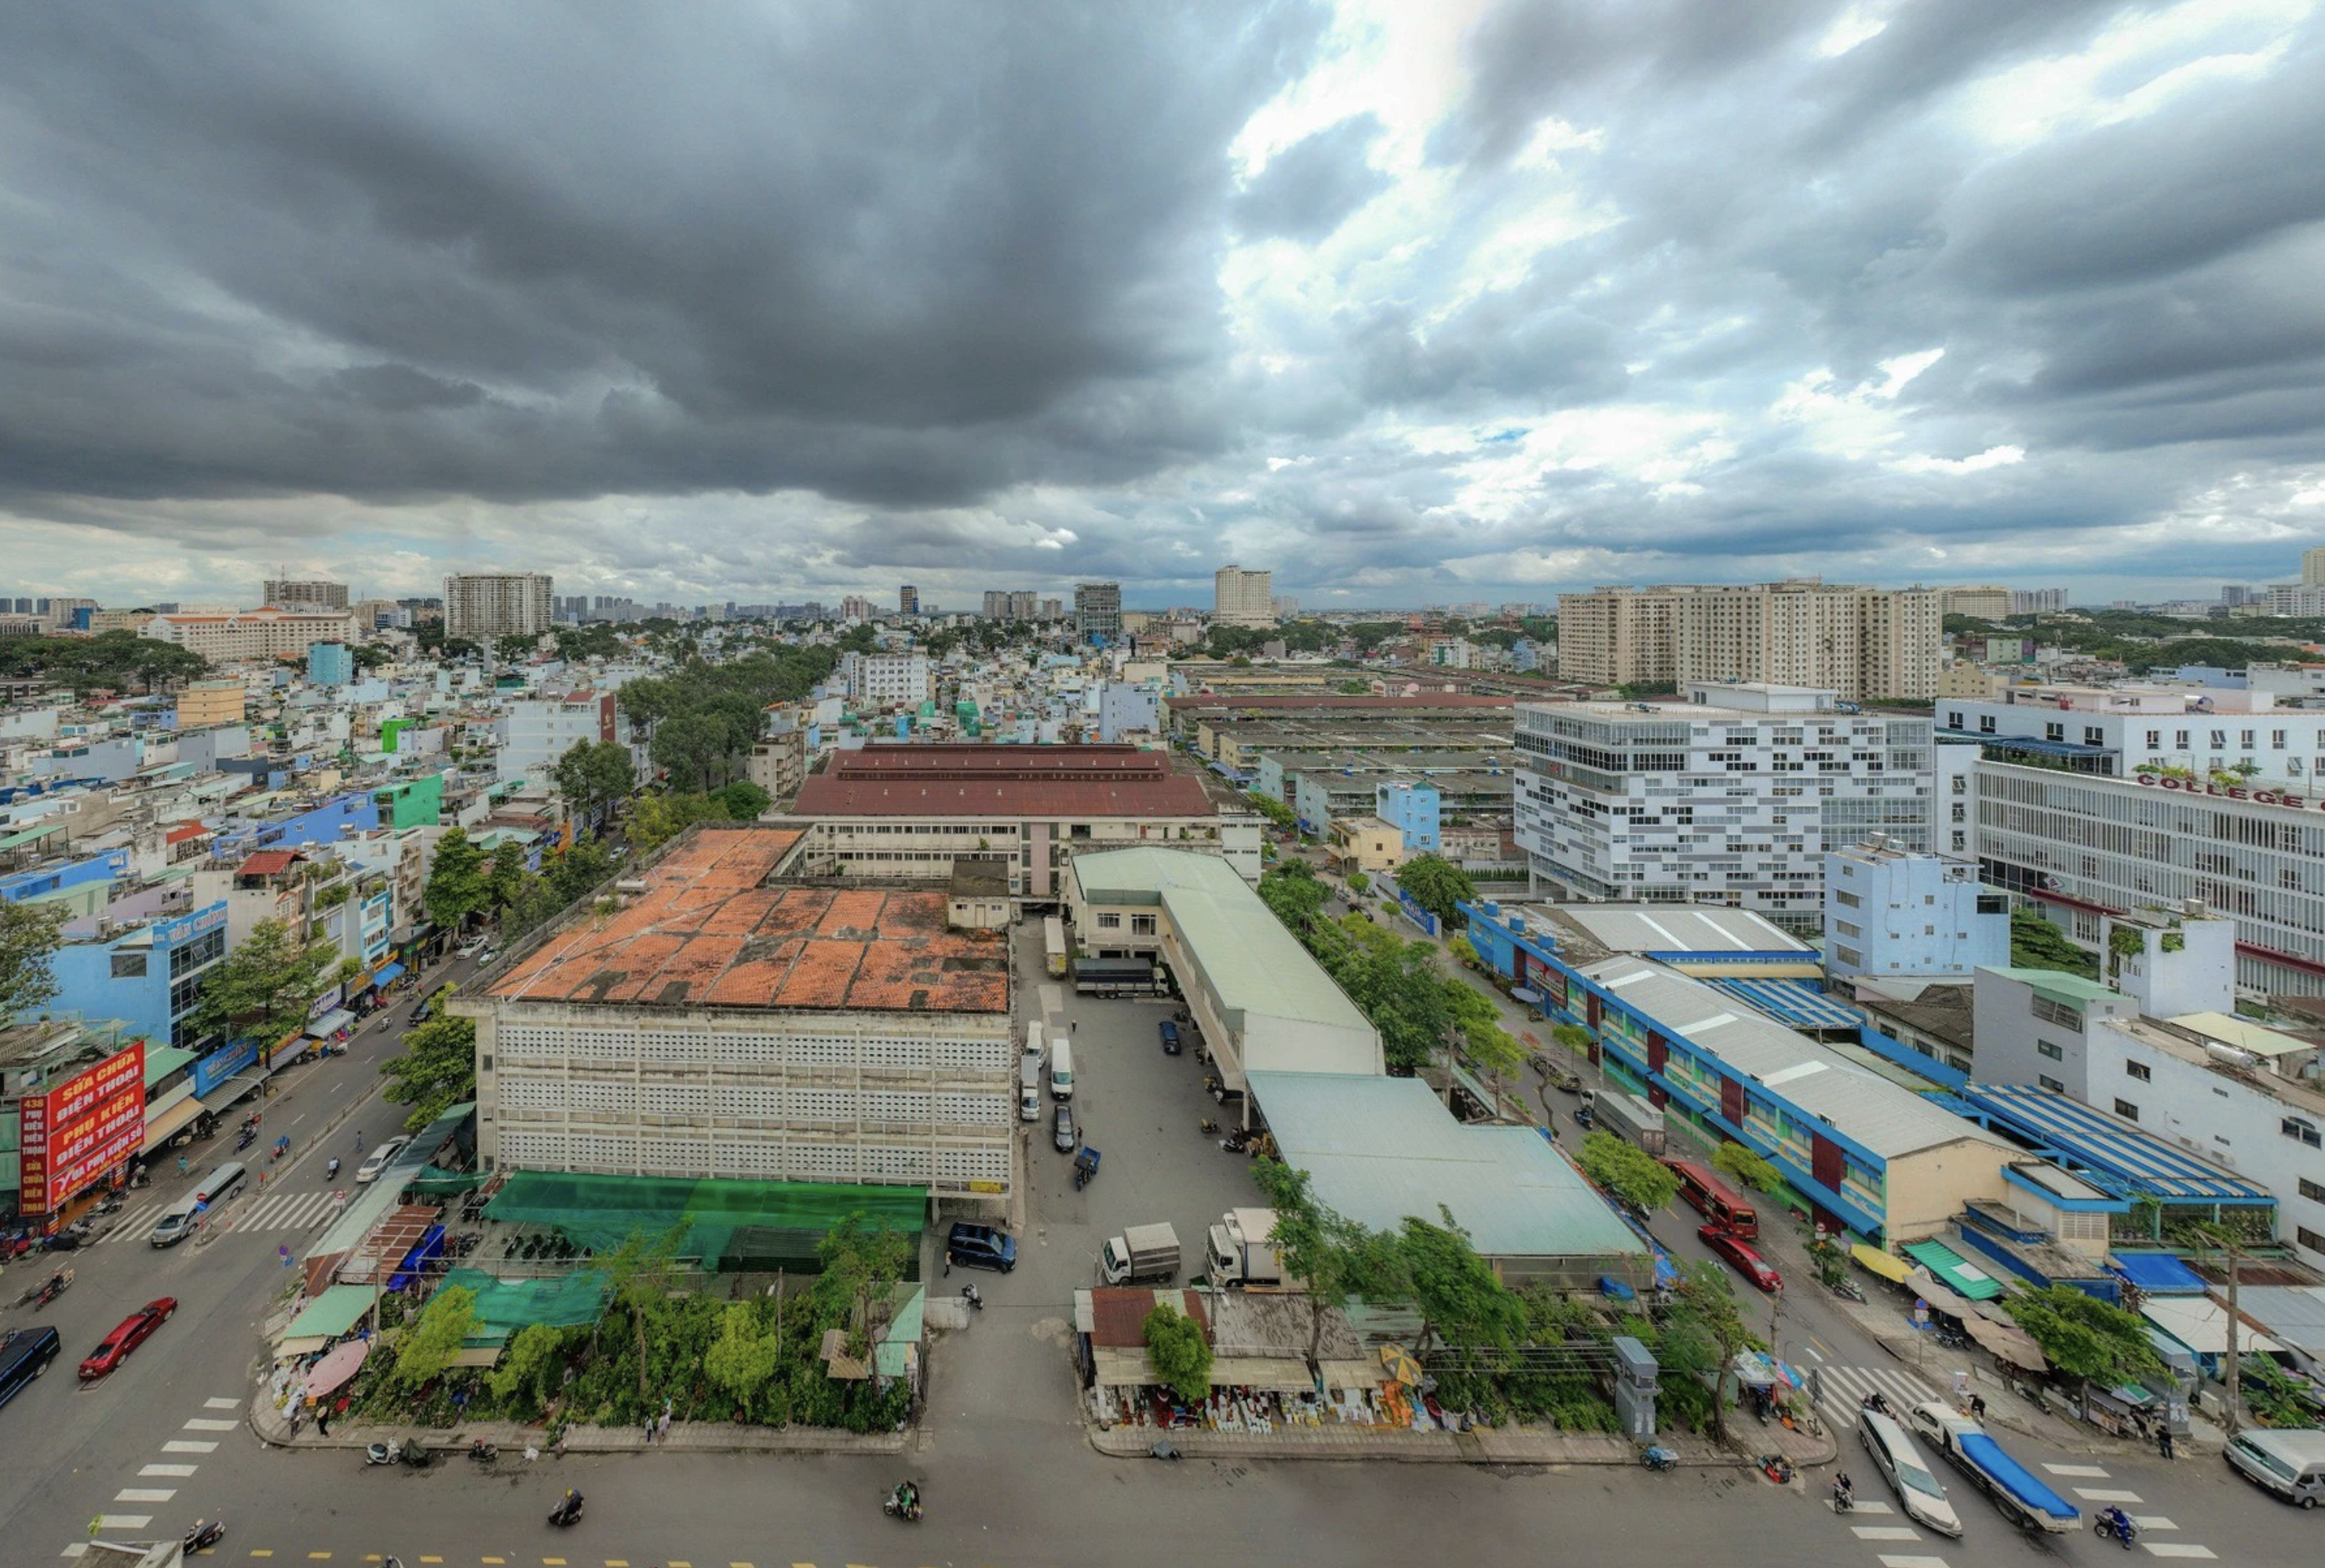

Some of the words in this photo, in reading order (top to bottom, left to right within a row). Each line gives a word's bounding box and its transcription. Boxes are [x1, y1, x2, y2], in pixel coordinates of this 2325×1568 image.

[2137, 774, 2305, 809] COLLEGE
[56, 1091, 93, 1122] ĐIỆN
[97, 1064, 139, 1097] THOẠI
[63, 1076, 93, 1101] SỬA
[96, 1052, 136, 1081] CHỮA
[24, 1099, 44, 1108] 438
[25, 1110, 42, 1121] PHỤ
[63, 1117, 94, 1145] PHỤ
[100, 1092, 134, 1122] KIỆN
[22, 1146, 46, 1157] THOẠI
[56, 1133, 93, 1166] ĐIỆN
[97, 1104, 139, 1139] THOẠI
[22, 1202, 46, 1212] THOẠI
